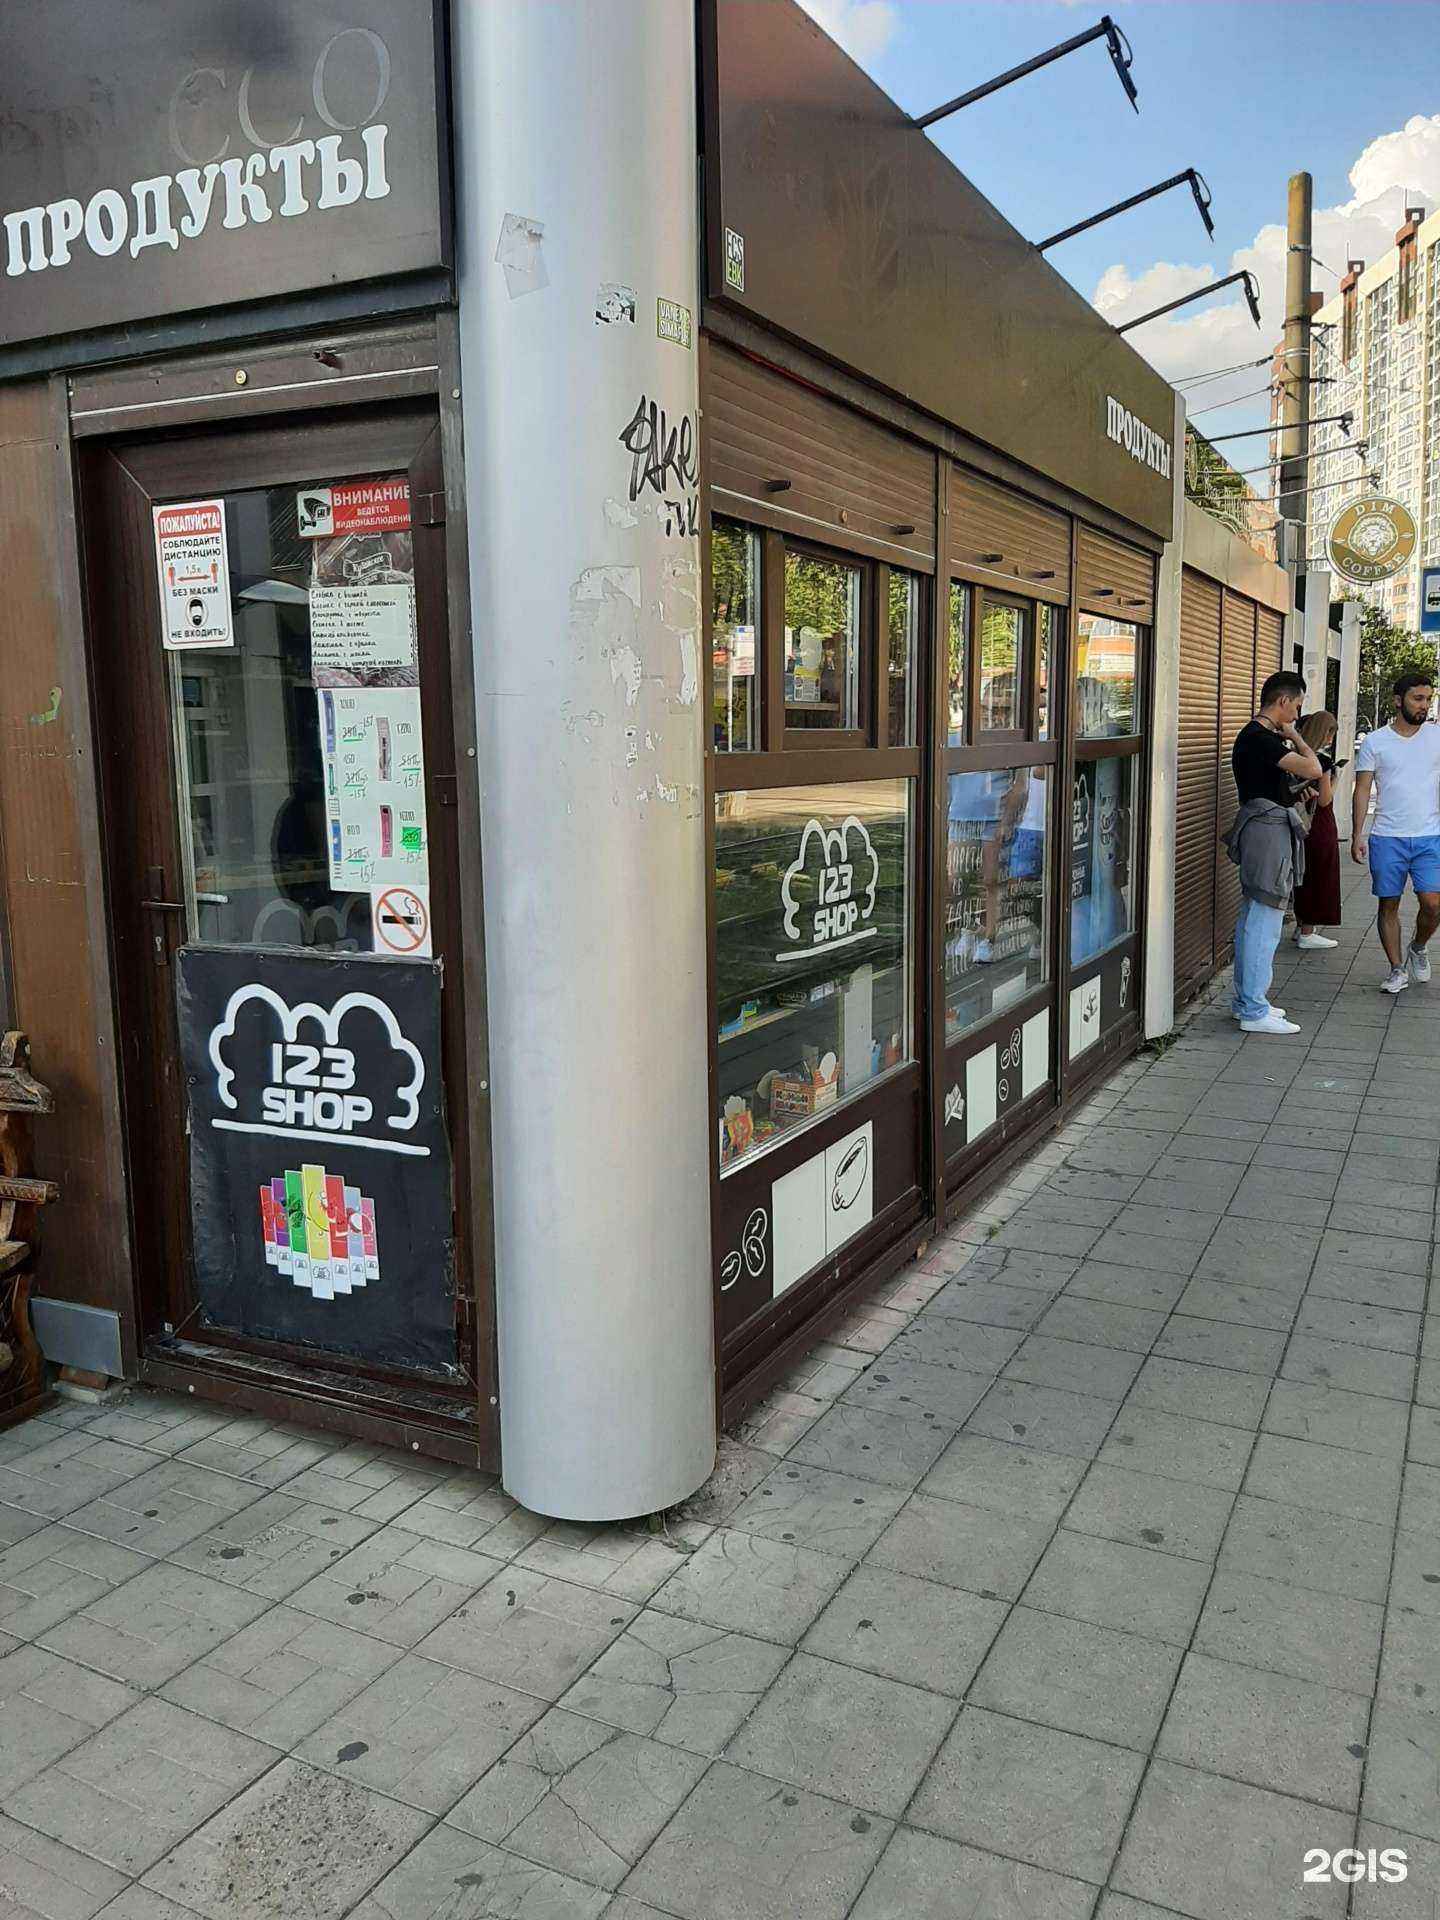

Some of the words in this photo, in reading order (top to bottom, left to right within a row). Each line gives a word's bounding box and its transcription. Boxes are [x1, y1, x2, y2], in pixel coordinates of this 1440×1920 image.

[3, 124, 391, 276] ПРОДУКТЫ
[1106, 395, 1171, 480] ПРОДУКТЫ
[333, 485, 410, 506] ВНИМАНИЕ
[1355, 501, 1395, 516] DIM
[160, 510, 220, 534] ПОЖАЛУЙСТА!
[163, 535, 221, 549] СОБЛЮДАЙТЕ
[164, 547, 221, 562] ДИСТАНЦИЮ
[1342, 553, 1406, 576] COFFEE
[172, 587, 188, 597] БЕЗ
[189, 585, 219, 596] МАСКИ
[171, 629, 182, 639] НЕ
[818, 864, 853, 906] 123
[813, 901, 858, 943] SHOP
[272, 1043, 356, 1090] 123
[263, 1087, 373, 1131] SHOP
